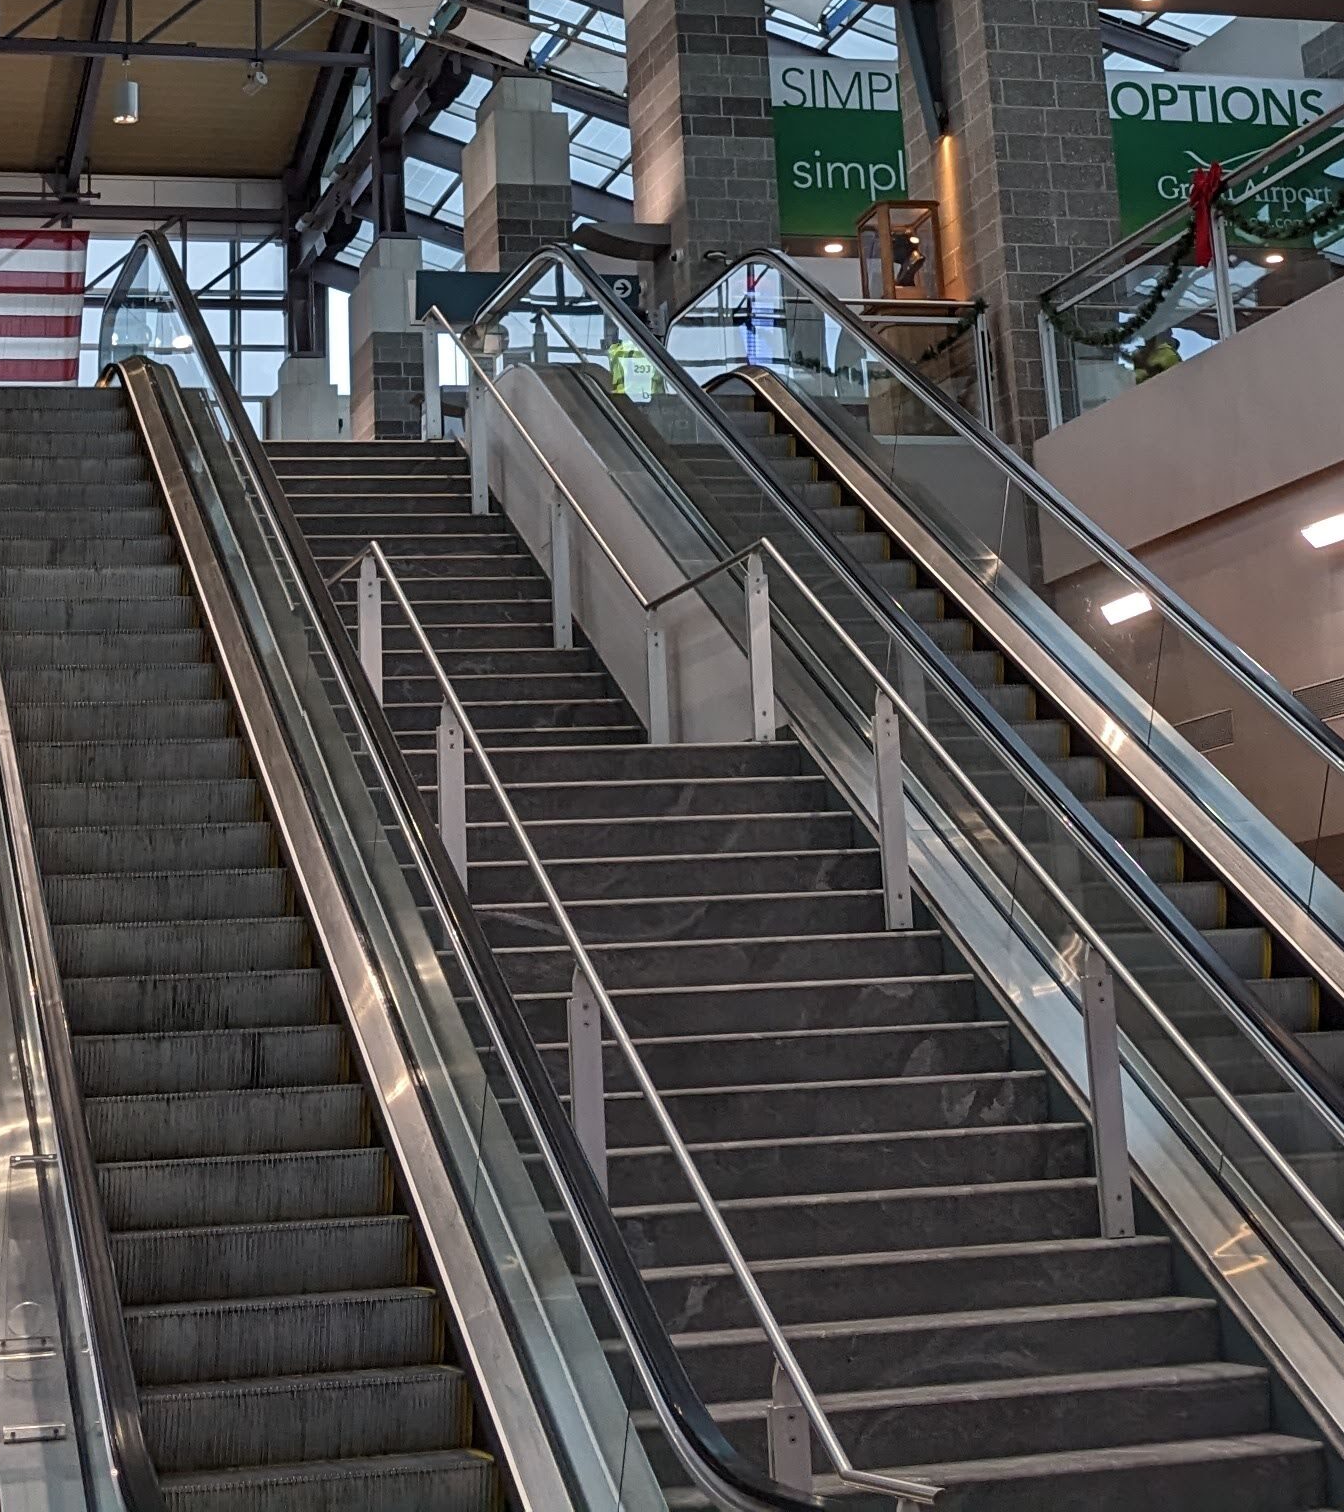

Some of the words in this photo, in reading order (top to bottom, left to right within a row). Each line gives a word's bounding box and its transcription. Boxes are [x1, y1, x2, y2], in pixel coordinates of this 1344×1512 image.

[1110, 81, 1325, 130] OPTIONS
[1158, 175, 1235, 202] Grn
[1243, 178, 1335, 213] Airport
